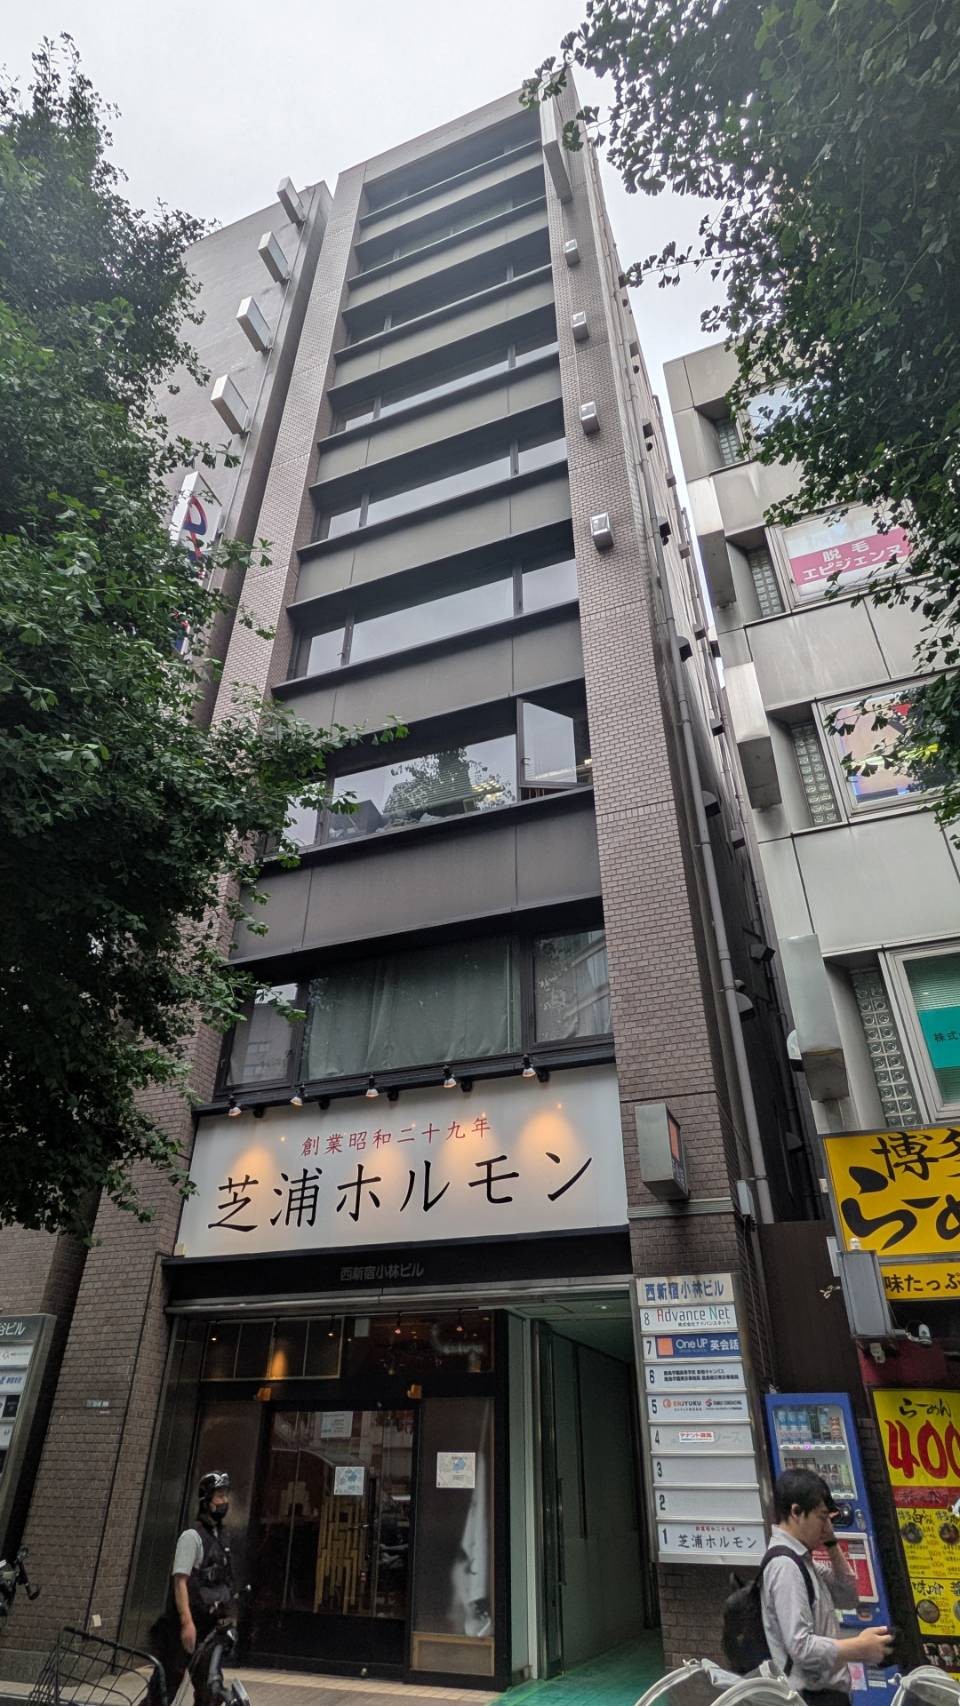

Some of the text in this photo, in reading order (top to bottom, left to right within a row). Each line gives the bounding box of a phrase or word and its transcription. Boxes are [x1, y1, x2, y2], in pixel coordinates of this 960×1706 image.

[822, 541, 870, 562] 脱毛
[934, 1030, 960, 1045] 株式
[301, 1116, 492, 1157] 創業昭和二十九年
[207, 1151, 593, 1232] 芝浦ホルモン
[340, 1261, 425, 1281] 西新宿小林ビル
[644, 1280, 724, 1301] 西新宿小林ビル
[643, 1306, 731, 1326] 8 Advance Net
[646, 1340, 652, 1355] 7
[710, 1339, 740, 1351] 英会話
[649, 1369, 655, 1384] 6
[651, 1399, 658, 1414] 5
[654, 1429, 660, 1444] 4
[656, 1462, 663, 1478] 3
[659, 1494, 666, 1511] 2
[662, 1528, 757, 1549] 1 芝浦ホルモン
